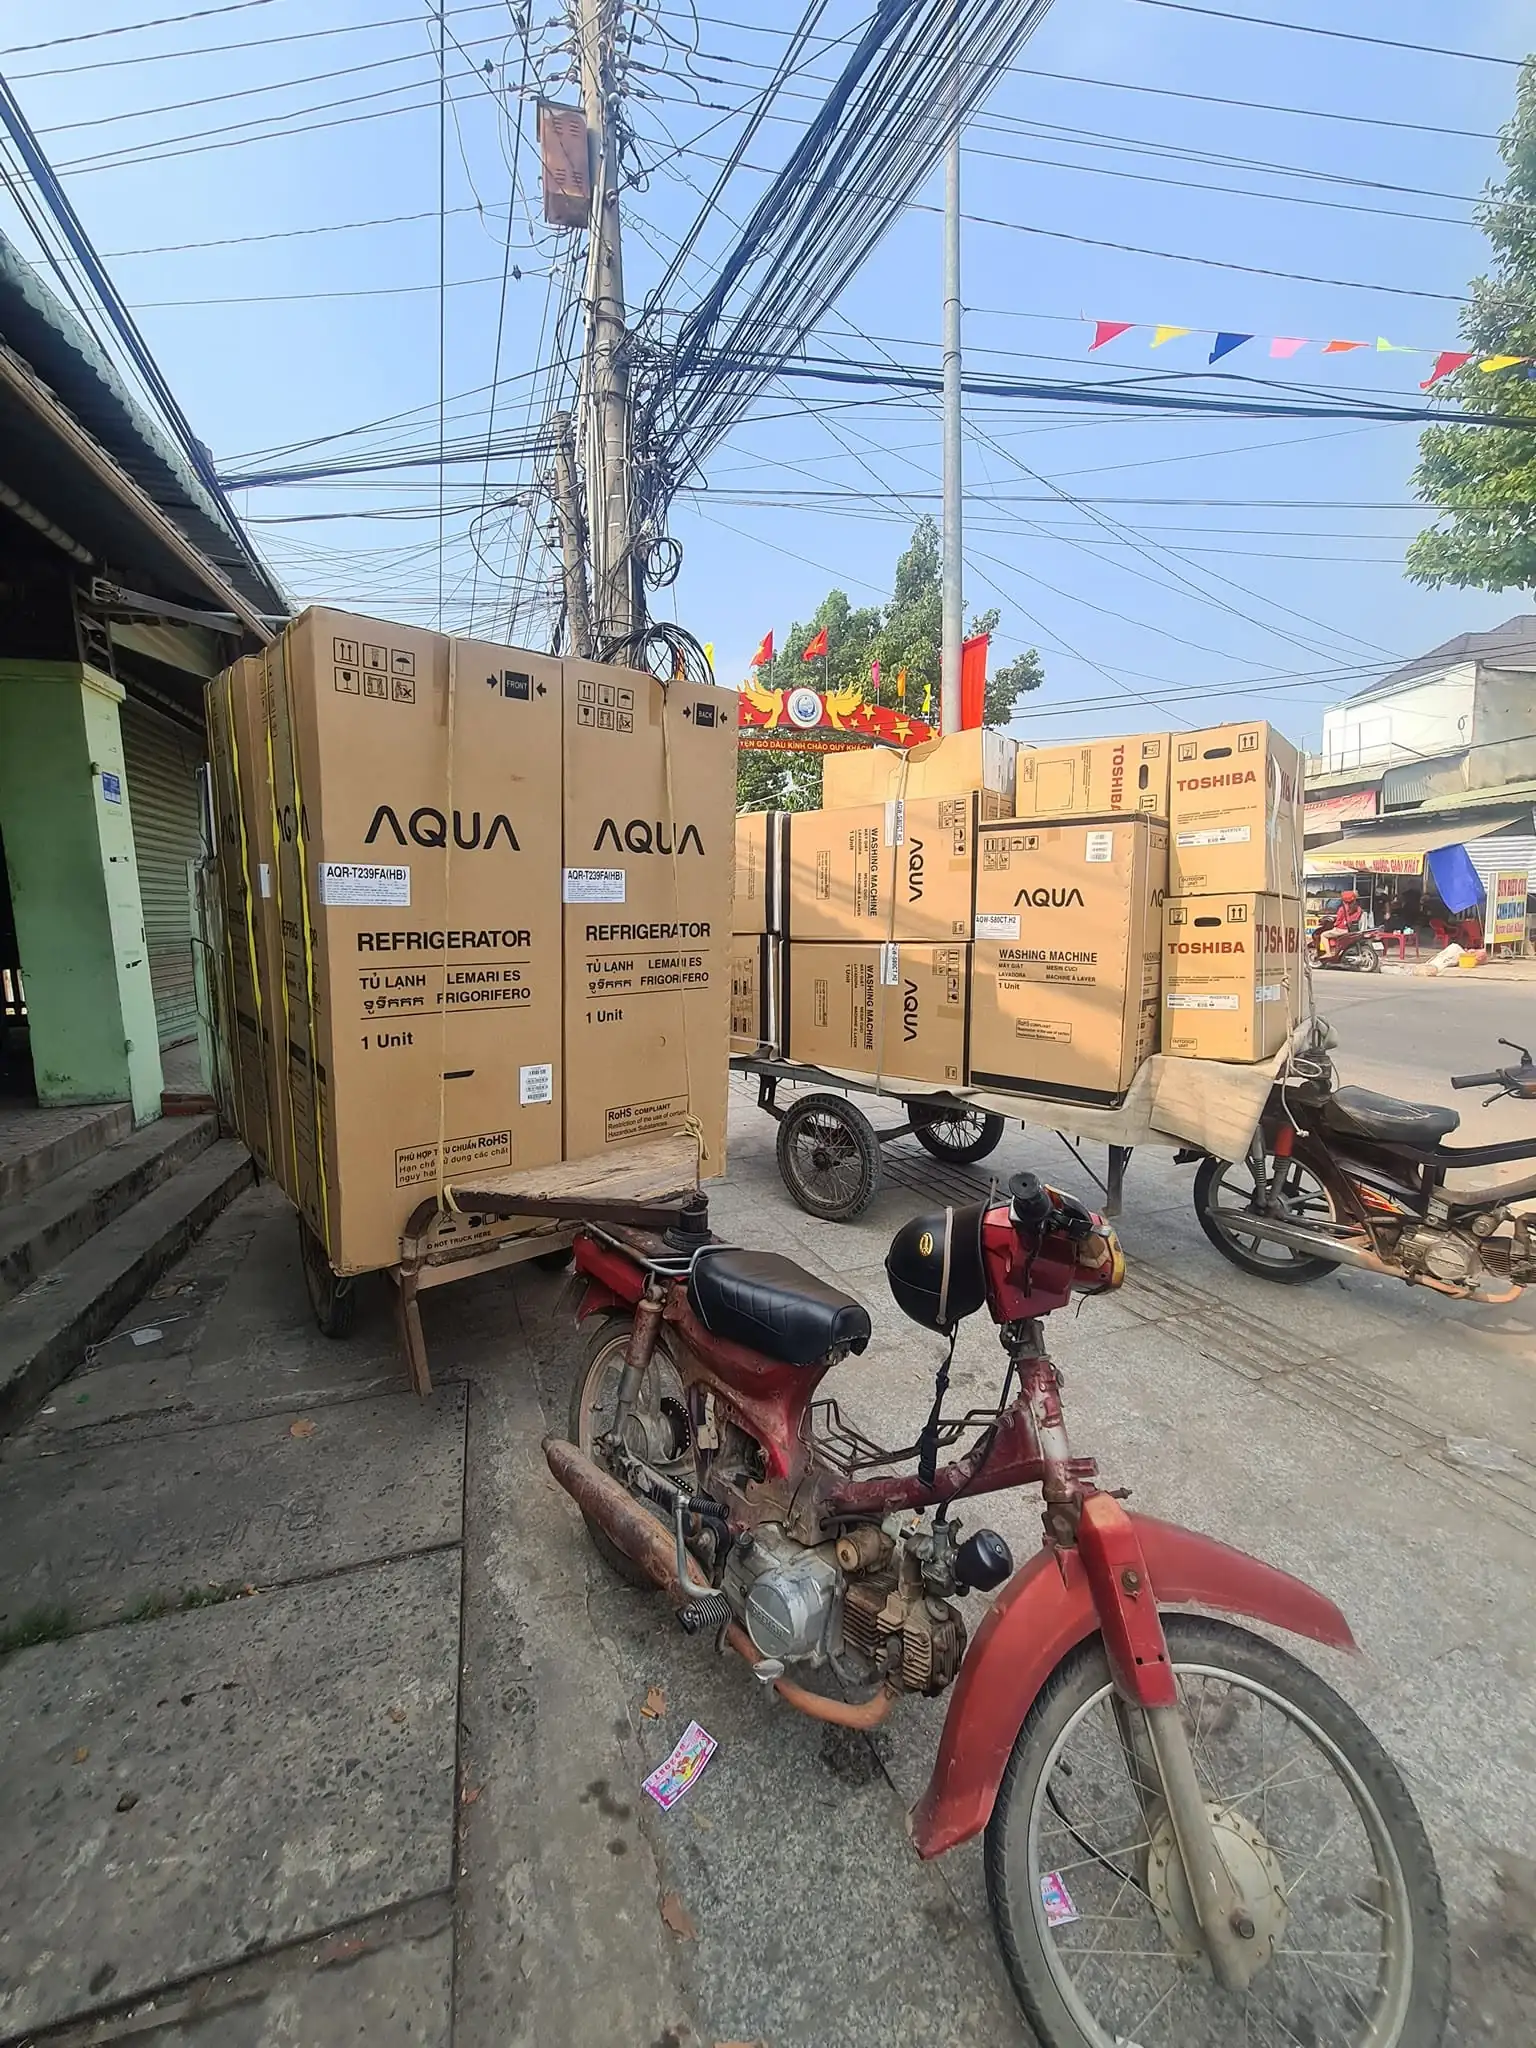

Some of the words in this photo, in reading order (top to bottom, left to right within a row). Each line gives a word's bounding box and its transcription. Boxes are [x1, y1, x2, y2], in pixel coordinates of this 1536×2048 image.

[506, 679, 528, 692] FRONT
[698, 710, 713, 720] BACK
[807, 741, 828, 750] CHÀO
[1111, 744, 1124, 811] TOSHIBA
[1176, 770, 1256, 792] TOSHIBA
[364, 805, 521, 851] AQUA
[593, 818, 705, 856] AQUA
[870, 827, 879, 872] WASHING
[327, 865, 407, 881] AQR-T239FA(HB)
[567, 870, 623, 881] AQR-T239FA(HB)
[908, 837, 924, 903] AQUA
[869, 872, 878, 917] MACHINE
[1014, 888, 1085, 908] AQUA
[1150, 888, 1164, 908] AQ
[586, 922, 711, 941] REFRIGERATOR
[357, 930, 531, 952] REFRIGERATOR
[1168, 941, 1245, 954] TOSHIBA
[689, 957, 702, 967] ES
[999, 949, 1046, 961] WASHING
[1049, 951, 1098, 963] MACHINE
[586, 958, 601, 973] TỦ
[604, 961, 634, 974] LẠNH
[359, 972, 380, 990] TỦ
[385, 974, 426, 991] LẠNH
[446, 971, 499, 985] LEMARI
[503, 970, 521, 982] ES
[640, 972, 709, 987] FRIGORIFERO
[866, 964, 874, 1007] WASHING
[1046, 974, 1070, 982] MACHINE
[436, 987, 531, 1005] FRIGORIFERO
[585, 1011, 592, 1024] 1
[597, 1008, 623, 1023] Unit
[903, 979, 919, 1042] AQUA
[865, 1009, 874, 1051] MACHINE
[361, 1036, 369, 1050] 1
[377, 1031, 414, 1049] Unit
[608, 1107, 632, 1121] RoHS
[634, 1103, 671, 1116] COMPLIANT
[477, 1133, 508, 1149] RoHS
[434, 1239, 448, 1248] NOT
[450, 1234, 473, 1245] TRUCK
[473, 1230, 492, 1239] HERE
